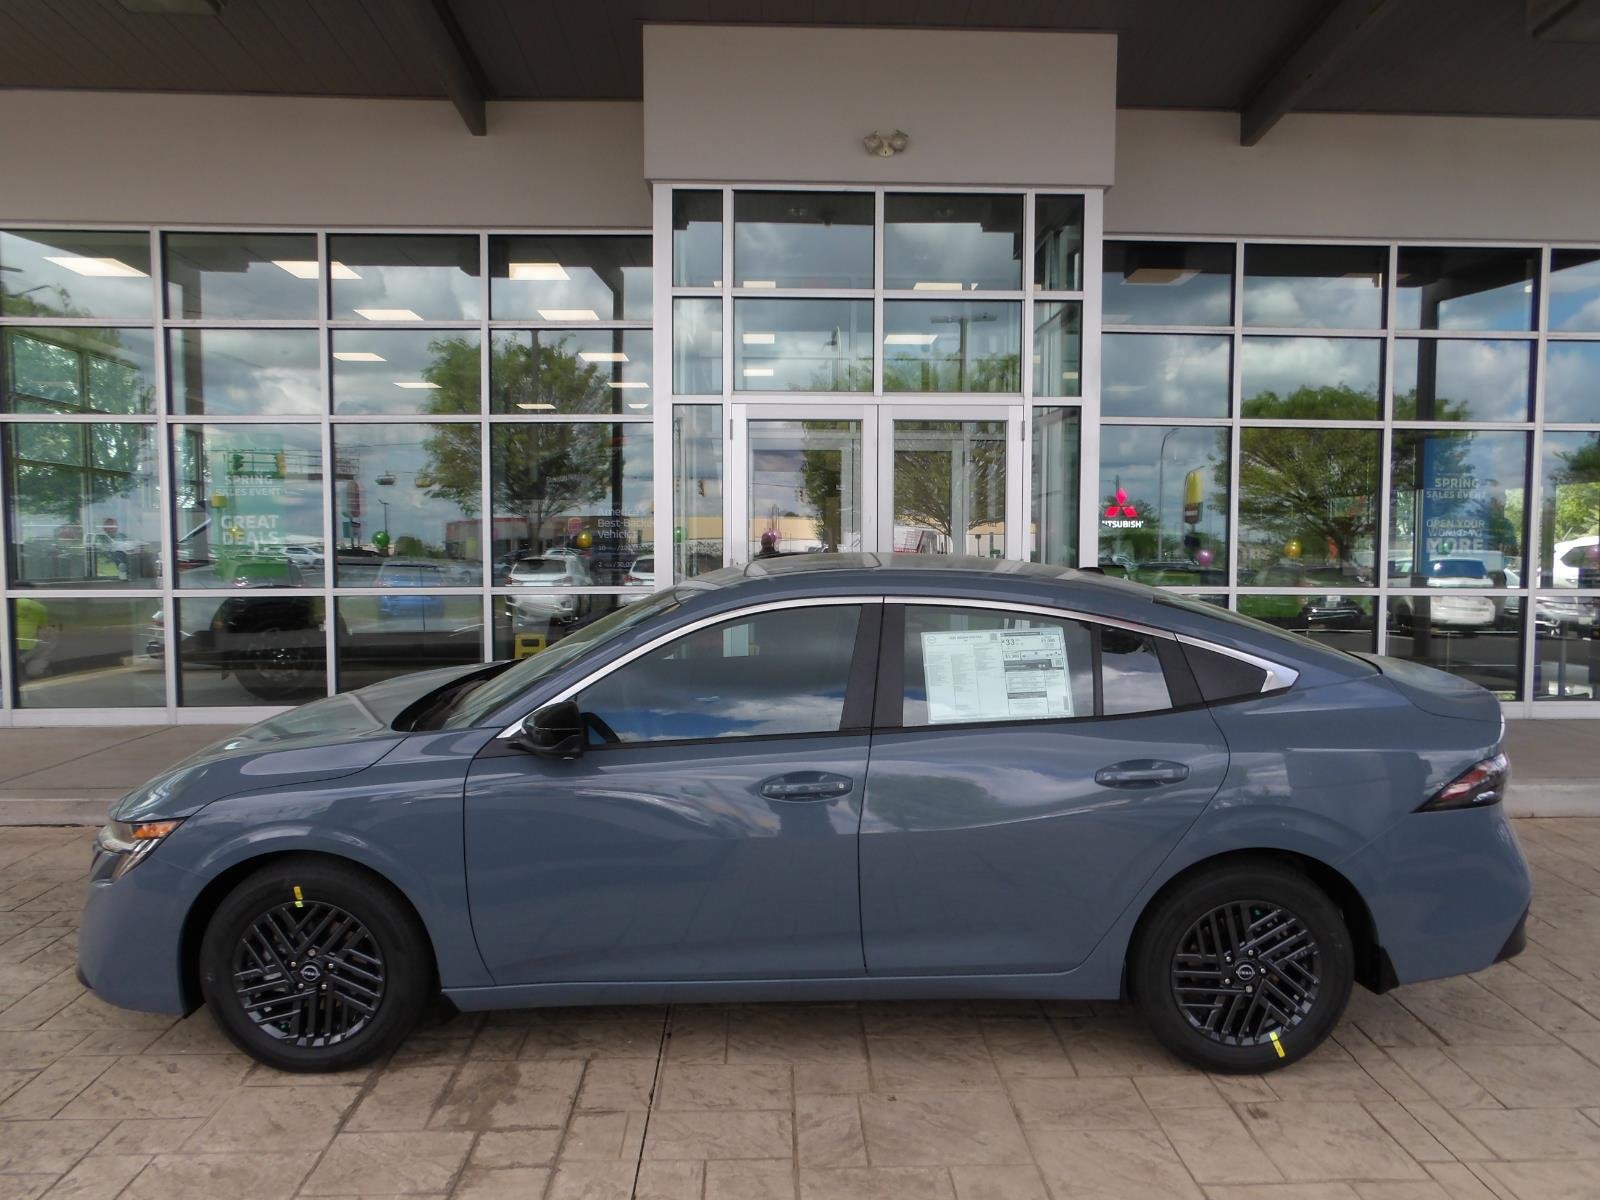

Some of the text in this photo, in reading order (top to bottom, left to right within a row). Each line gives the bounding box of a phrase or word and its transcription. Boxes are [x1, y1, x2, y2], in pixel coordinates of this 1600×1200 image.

[224, 475, 273, 485] SPRING
[1434, 478, 1480, 488] SPRING
[1426, 491, 1487, 499] SALES EVENT
[221, 515, 279, 528] GREAT
[1426, 520, 1485, 528] OPEN YOUR
[222, 531, 279, 545] DEALS
[1426, 538, 1484, 553] MORE
